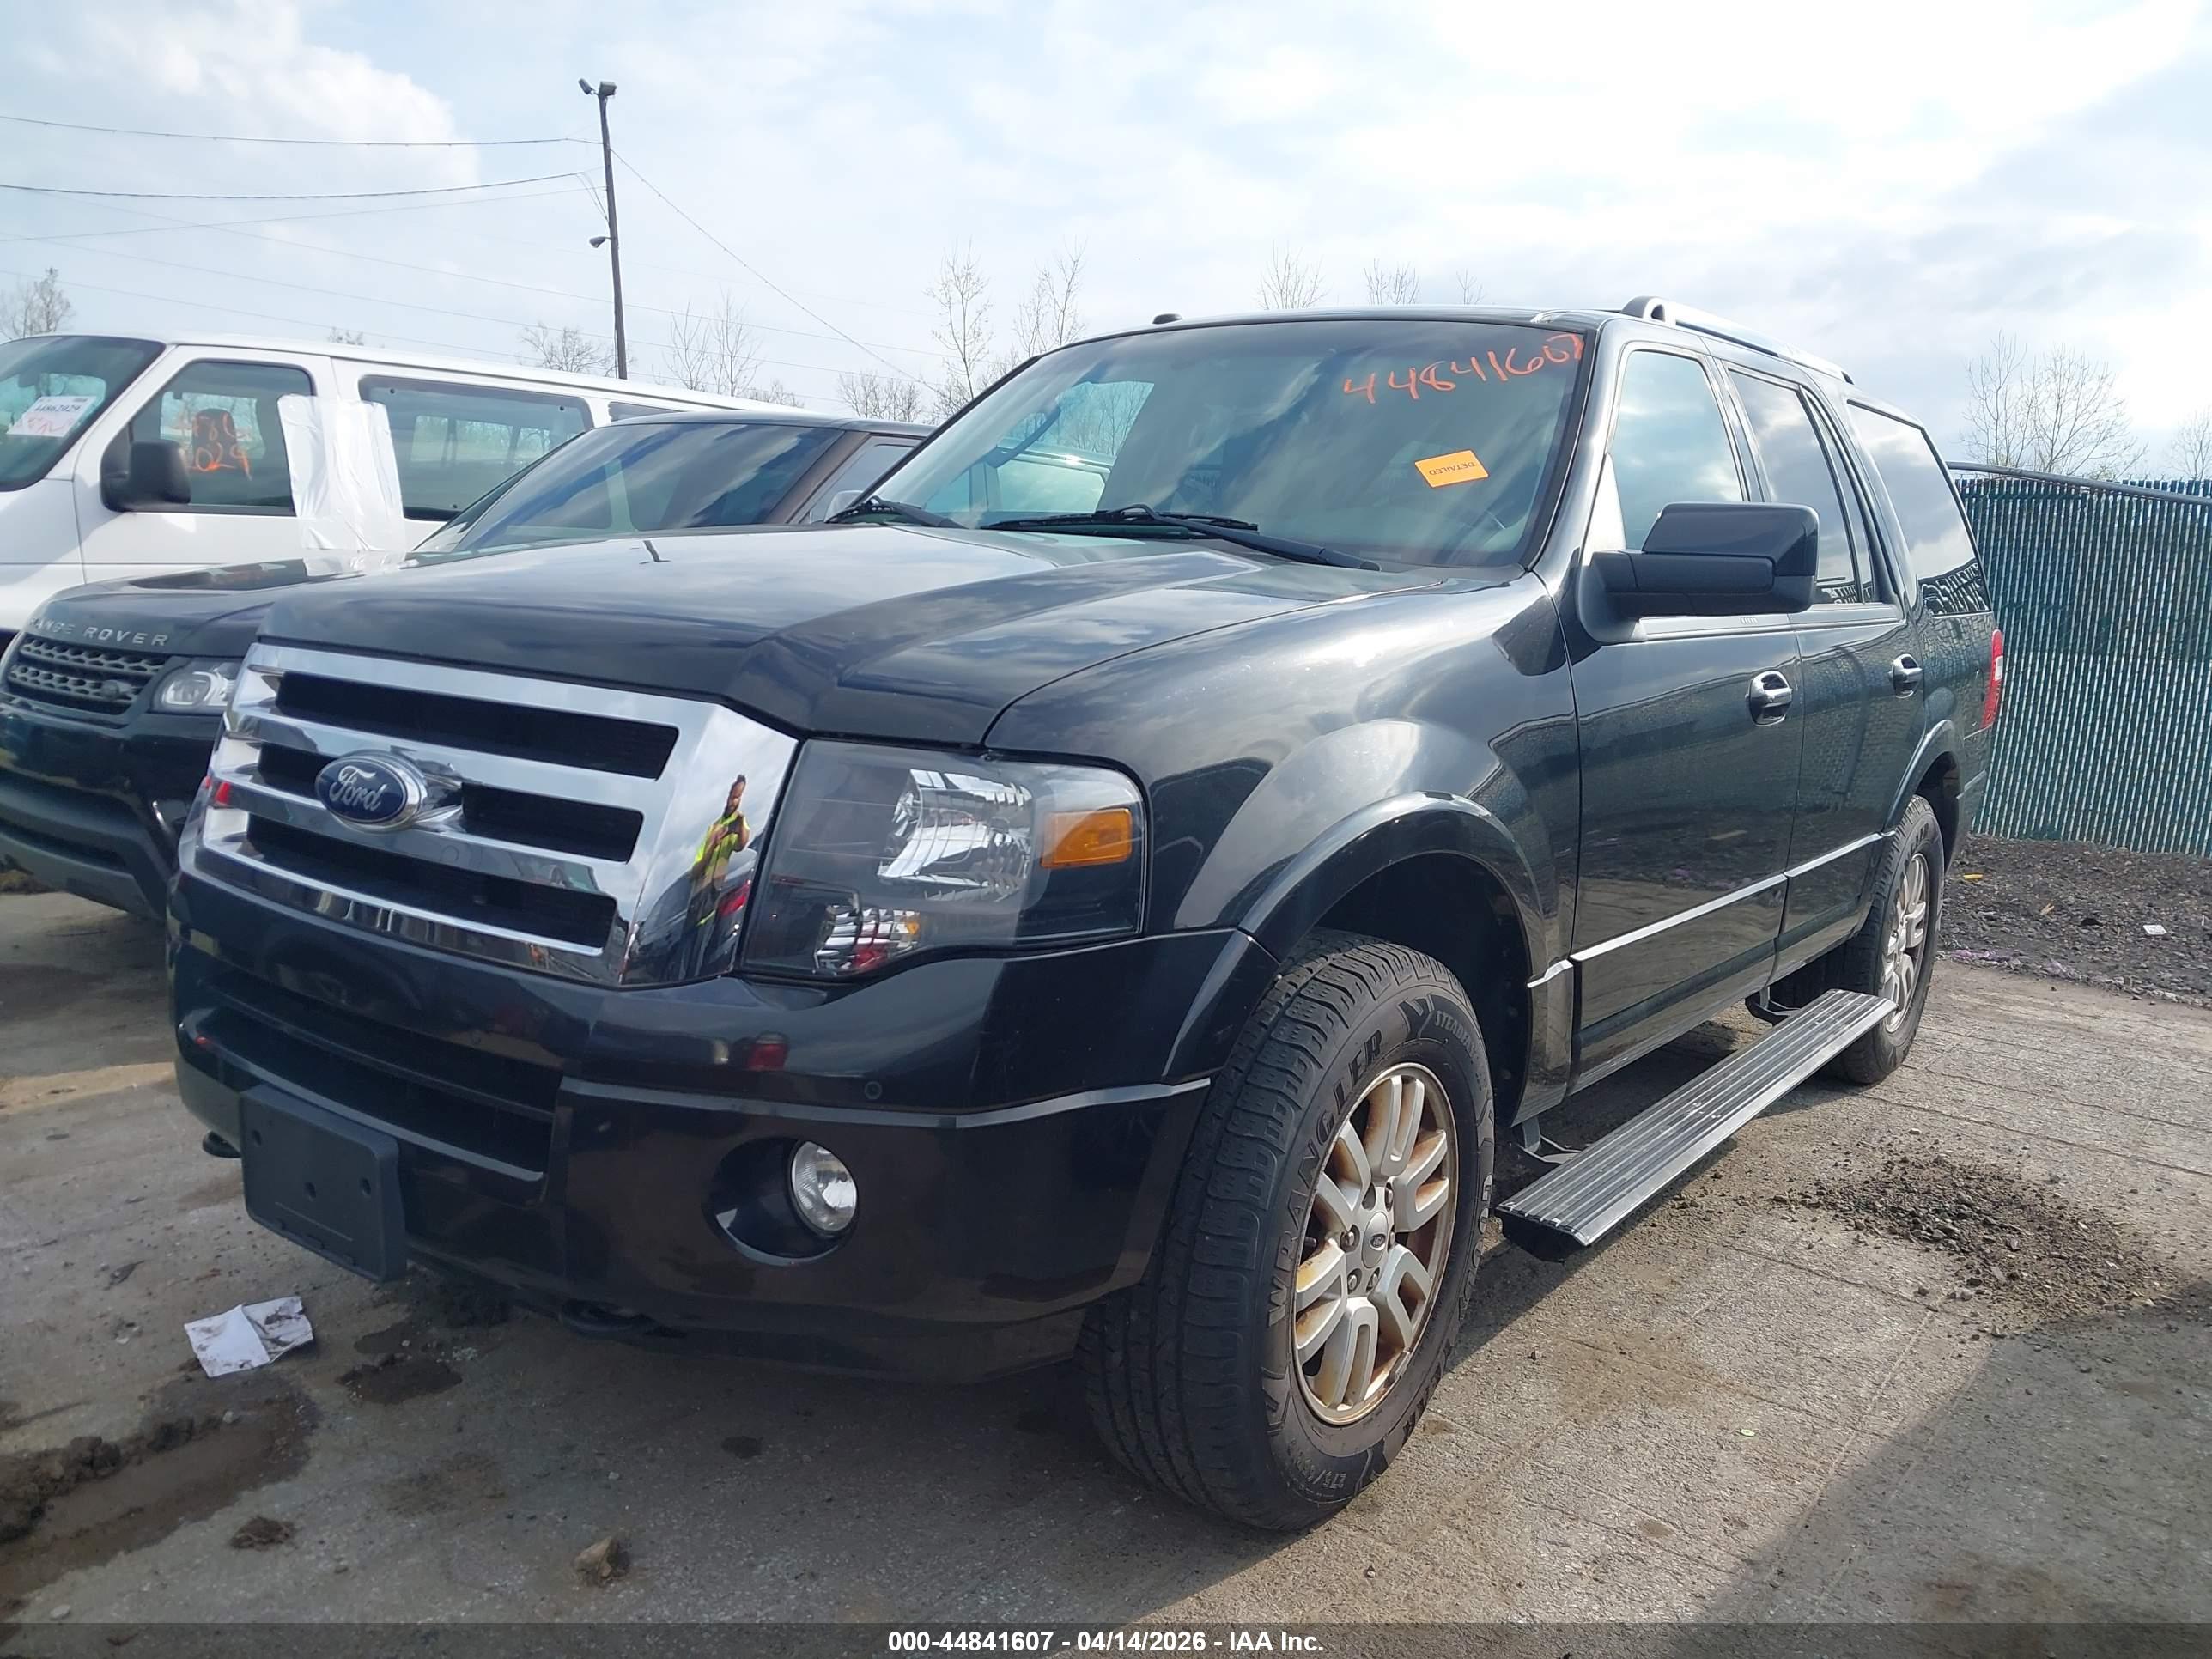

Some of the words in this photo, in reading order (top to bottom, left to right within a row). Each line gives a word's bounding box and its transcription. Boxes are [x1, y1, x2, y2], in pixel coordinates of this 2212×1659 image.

[1344, 331, 1584, 404] 44841607
[1429, 461, 1476, 476] DETAILED
[29, 617, 76, 635] RANGE
[83, 626, 169, 647] ROVER
[329, 765, 387, 811] Ford
